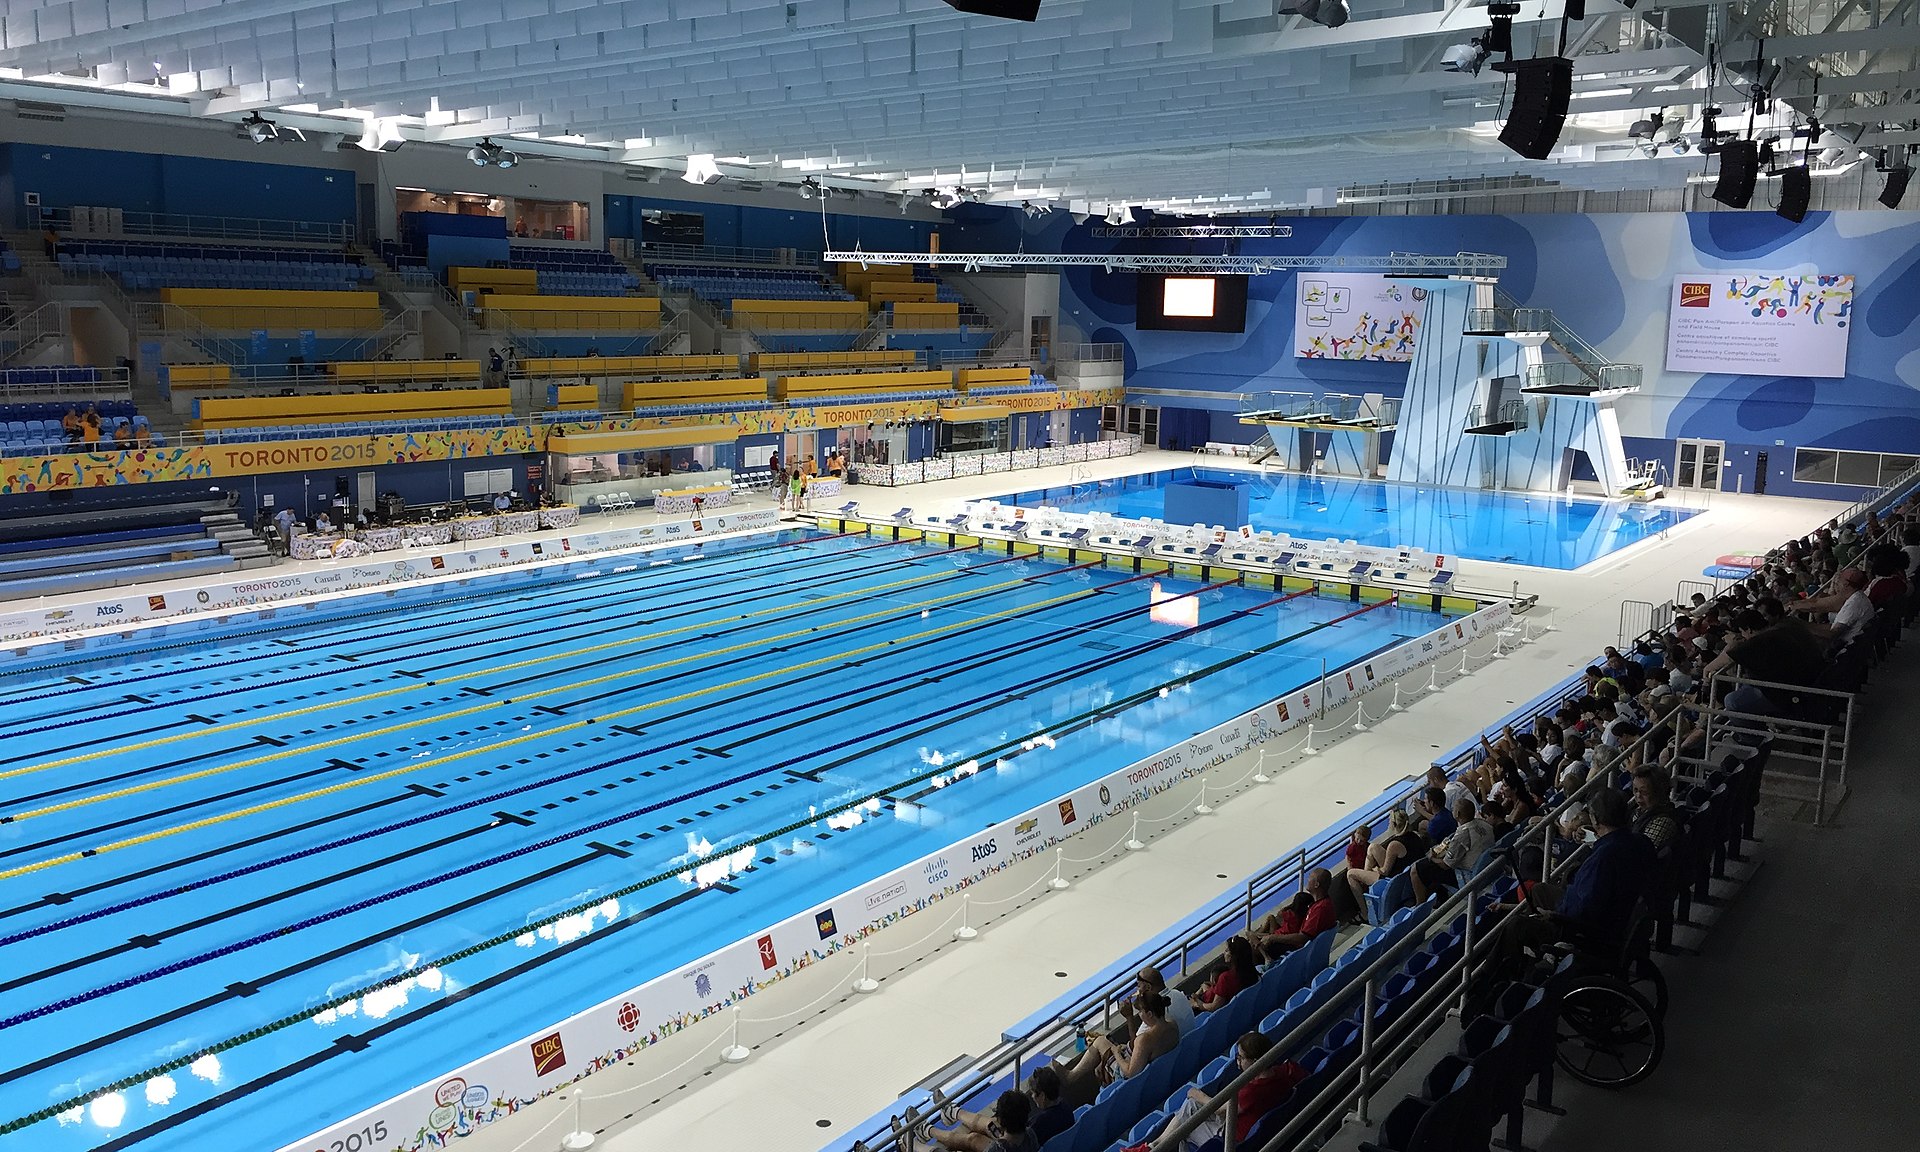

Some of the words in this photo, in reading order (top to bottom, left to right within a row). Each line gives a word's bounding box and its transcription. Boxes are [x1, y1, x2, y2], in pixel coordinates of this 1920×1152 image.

[1683, 285, 1710, 296] CIBC
[1016, 830, 1041, 846] CHEVROLET
[533, 1036, 561, 1058] CIBC
[441, 1084, 462, 1097] UNITED
